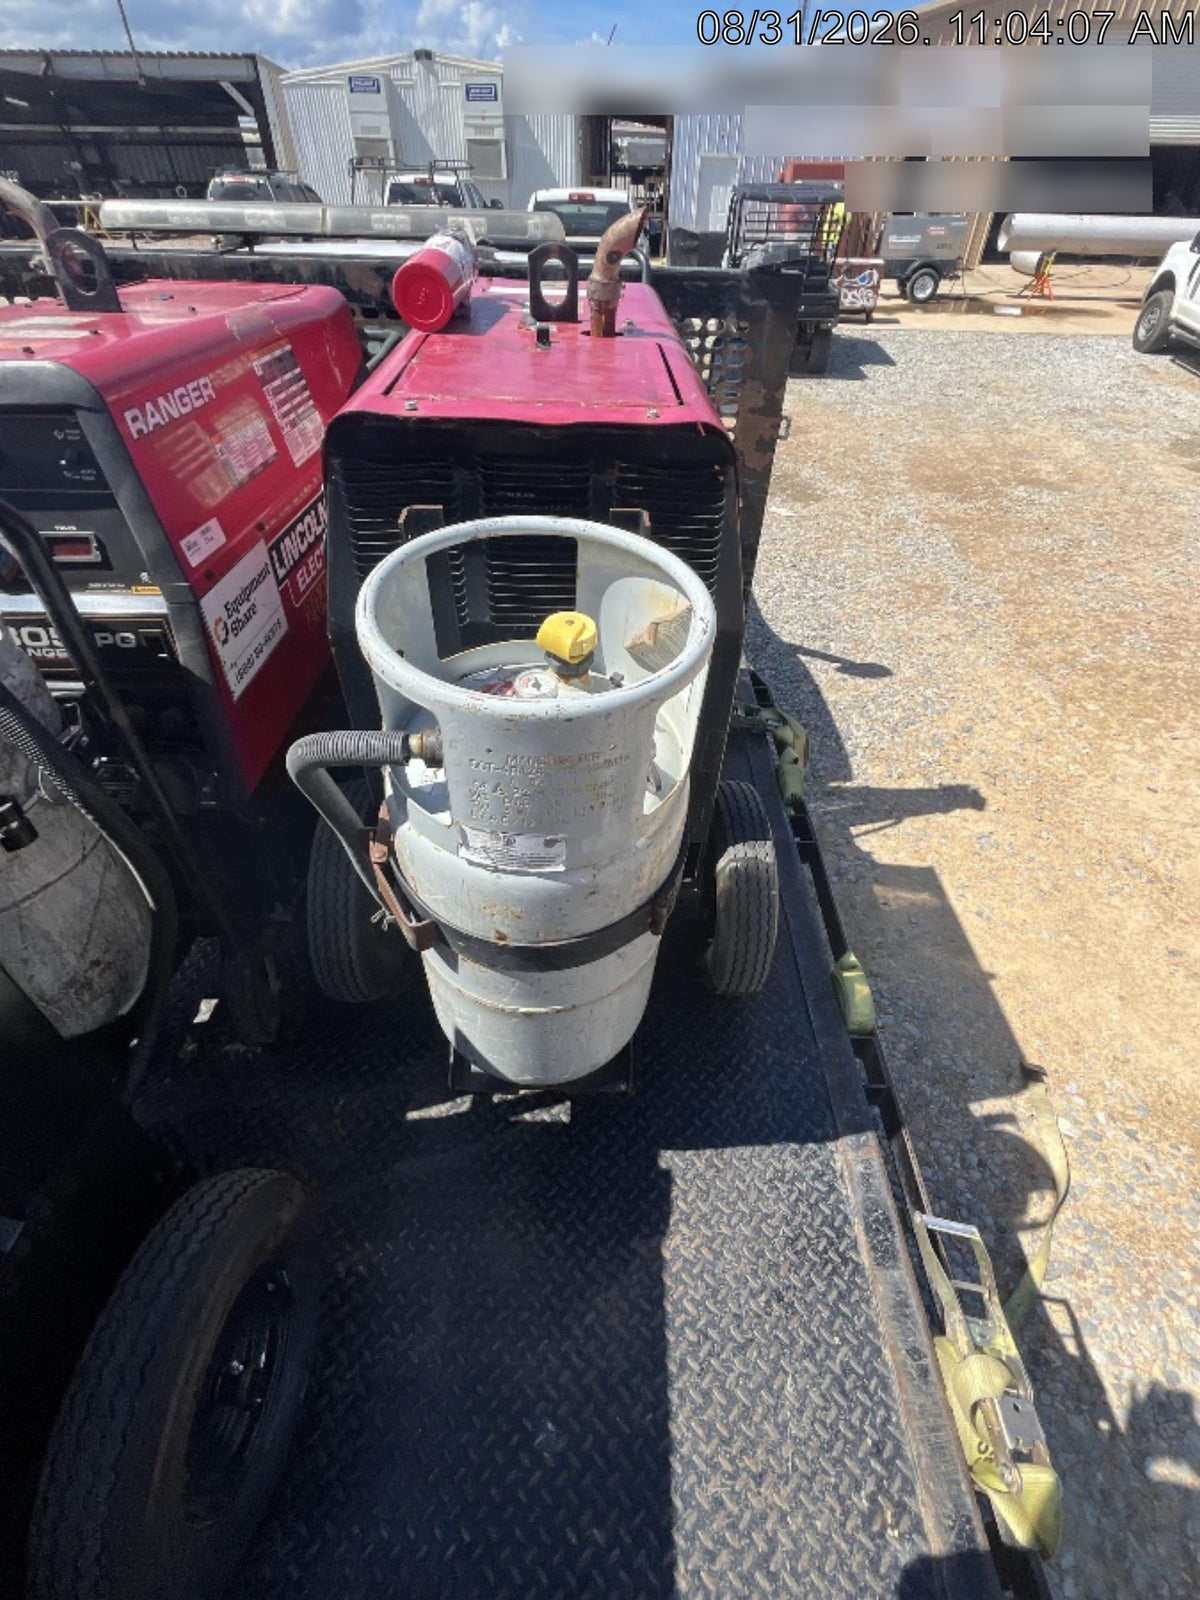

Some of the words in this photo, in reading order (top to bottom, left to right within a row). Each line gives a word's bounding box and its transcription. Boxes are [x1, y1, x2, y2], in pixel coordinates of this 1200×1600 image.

[123, 373, 217, 441] RANGER
[223, 561, 271, 618] Equipment
[229, 601, 258, 638] Share
